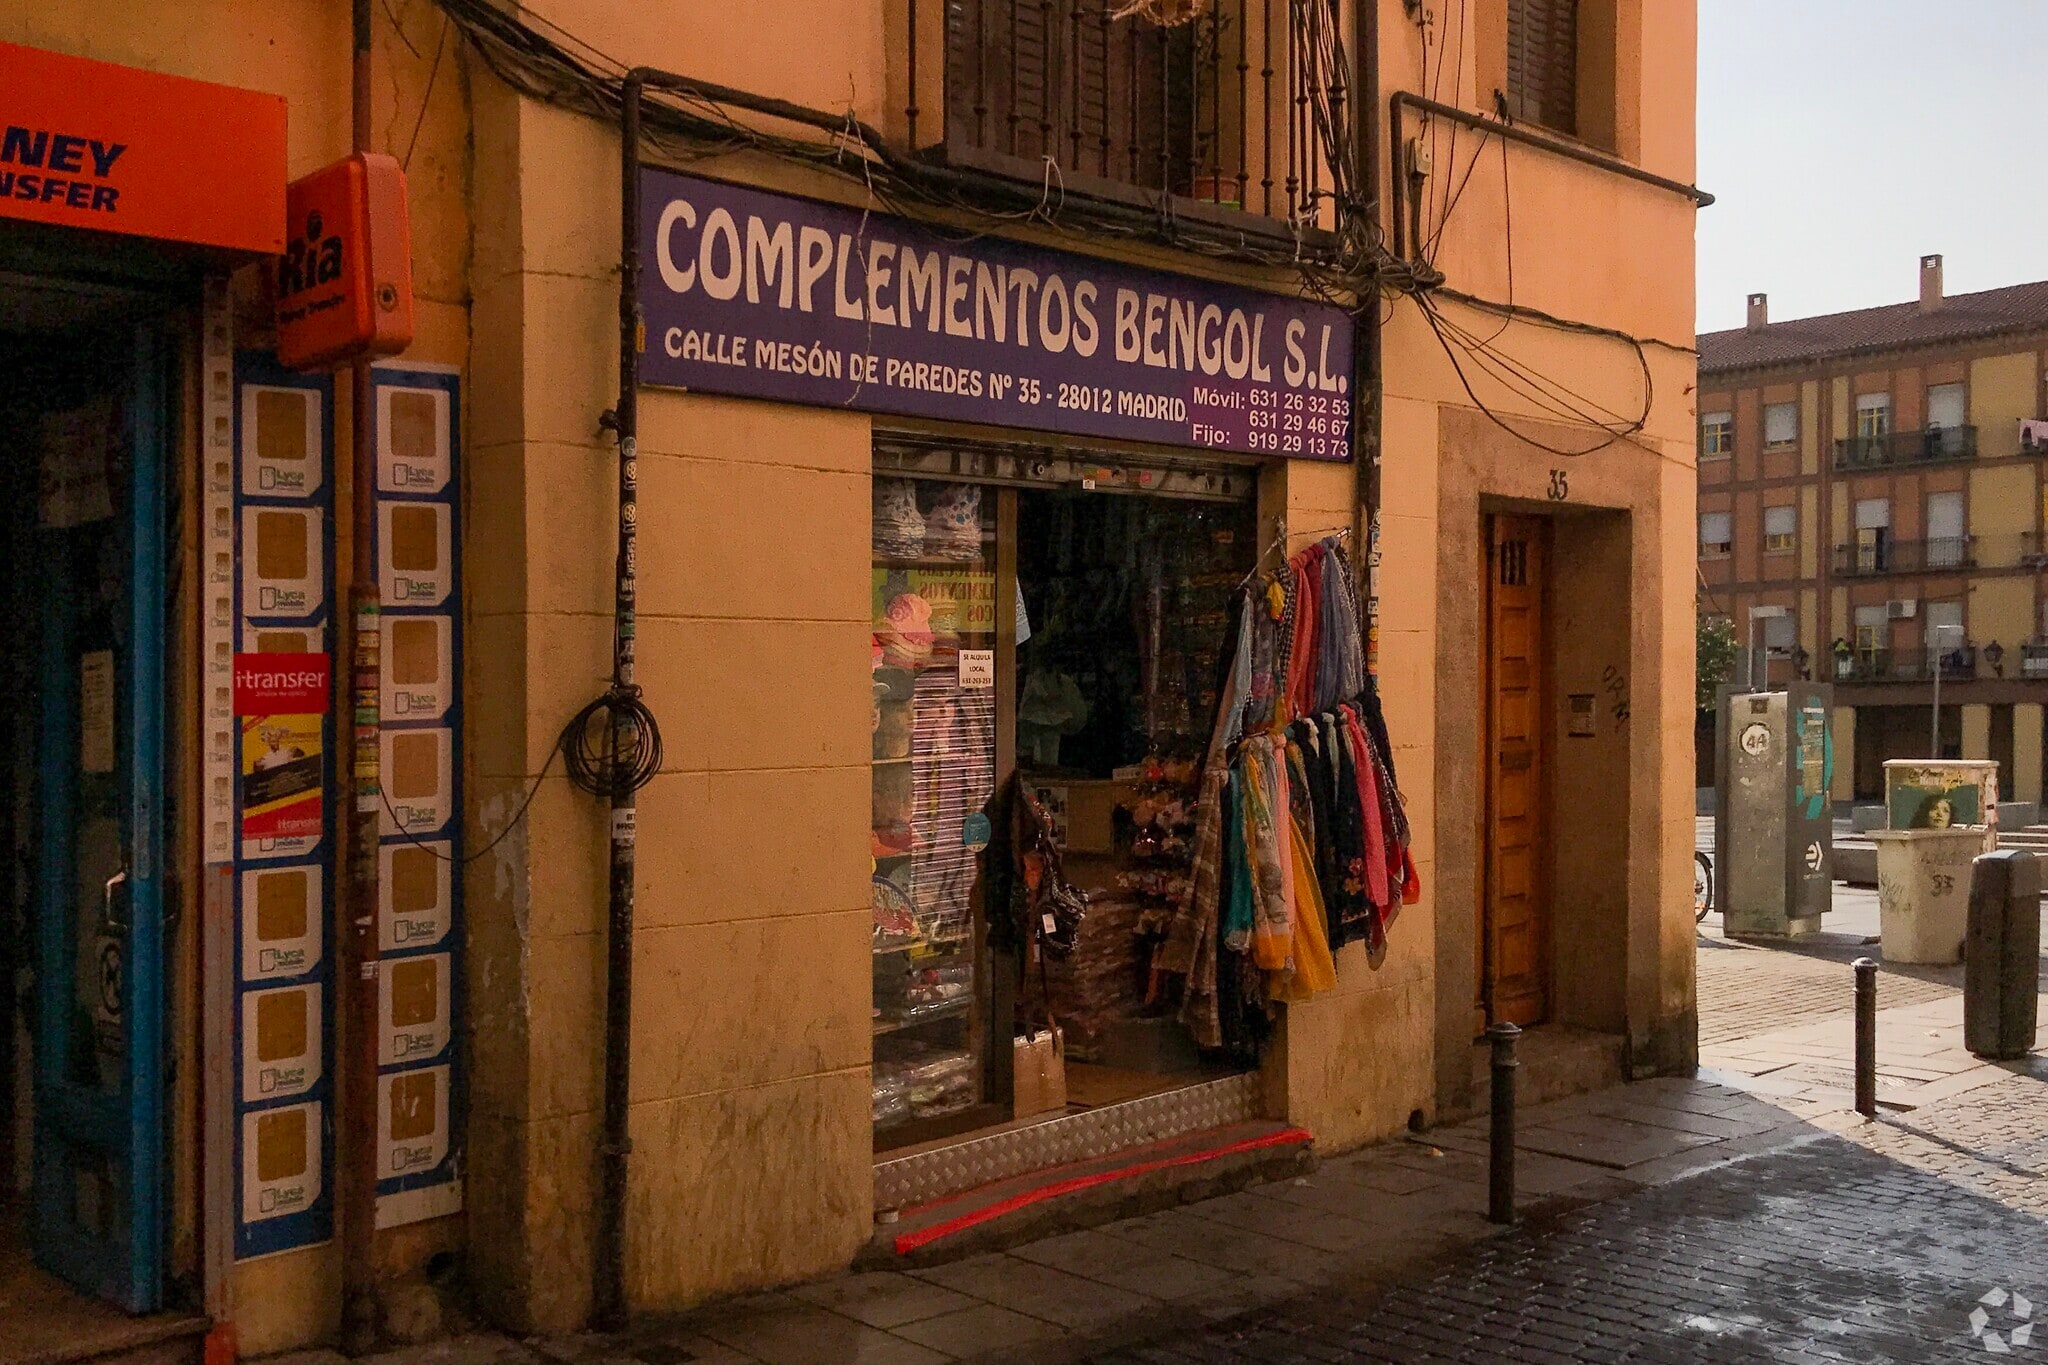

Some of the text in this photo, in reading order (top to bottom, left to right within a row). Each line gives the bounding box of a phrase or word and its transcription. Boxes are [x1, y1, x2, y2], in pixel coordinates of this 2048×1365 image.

[1, 125, 128, 178] NEY
[656, 199, 1348, 395] COMPLEMENTOS BENGOL S.L.
[664, 327, 747, 367] CALLE
[755, 339, 842, 379] MESÓN
[849, 353, 879, 384] DE
[886, 358, 983, 397] PAREDES
[1018, 377, 1041, 405] 35
[1058, 383, 1112, 414] 28012
[1193, 386, 1350, 416] Móvil: 631 26 32 53
[1192, 423, 1349, 457] Fijo: 919 29 13 73
[1249, 410, 1350, 437] 631 29 46 67
[1547, 469, 1568, 500] 35
